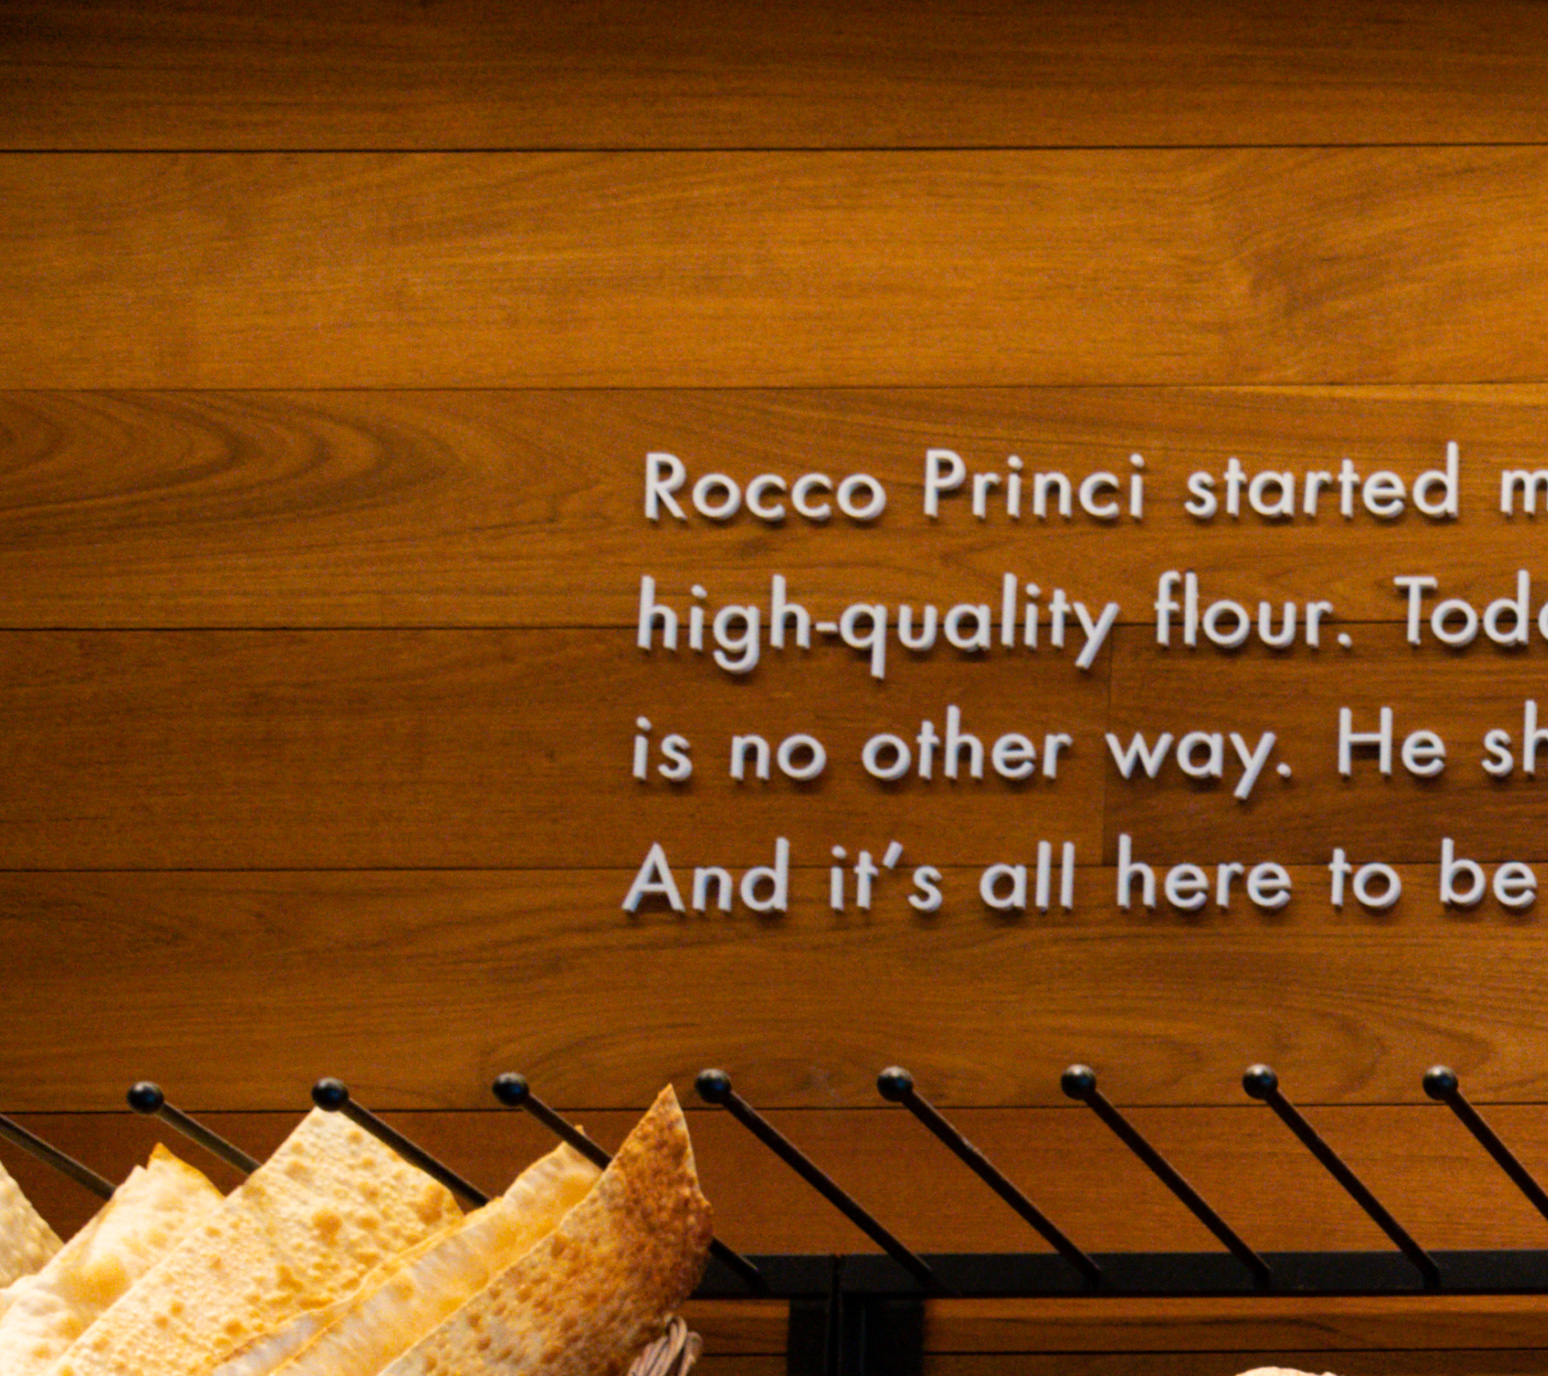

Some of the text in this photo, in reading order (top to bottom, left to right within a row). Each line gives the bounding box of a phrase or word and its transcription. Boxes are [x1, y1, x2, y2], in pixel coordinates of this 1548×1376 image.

[642, 449, 889, 521] Rocco
[921, 446, 1147, 519] Princi
[1182, 438, 1461, 518] started
[635, 570, 1122, 681] high-quality
[1152, 567, 1354, 648] flour.
[630, 714, 695, 781] is
[728, 731, 829, 781] no
[859, 702, 1075, 781] other
[1103, 729, 1294, 800] way.
[1336, 704, 1448, 777] He
[620, 835, 792, 914] And
[977, 838, 1077, 911] all
[1115, 831, 1294, 910] here
[1326, 846, 1404, 909] to
[1437, 835, 1540, 908] be
